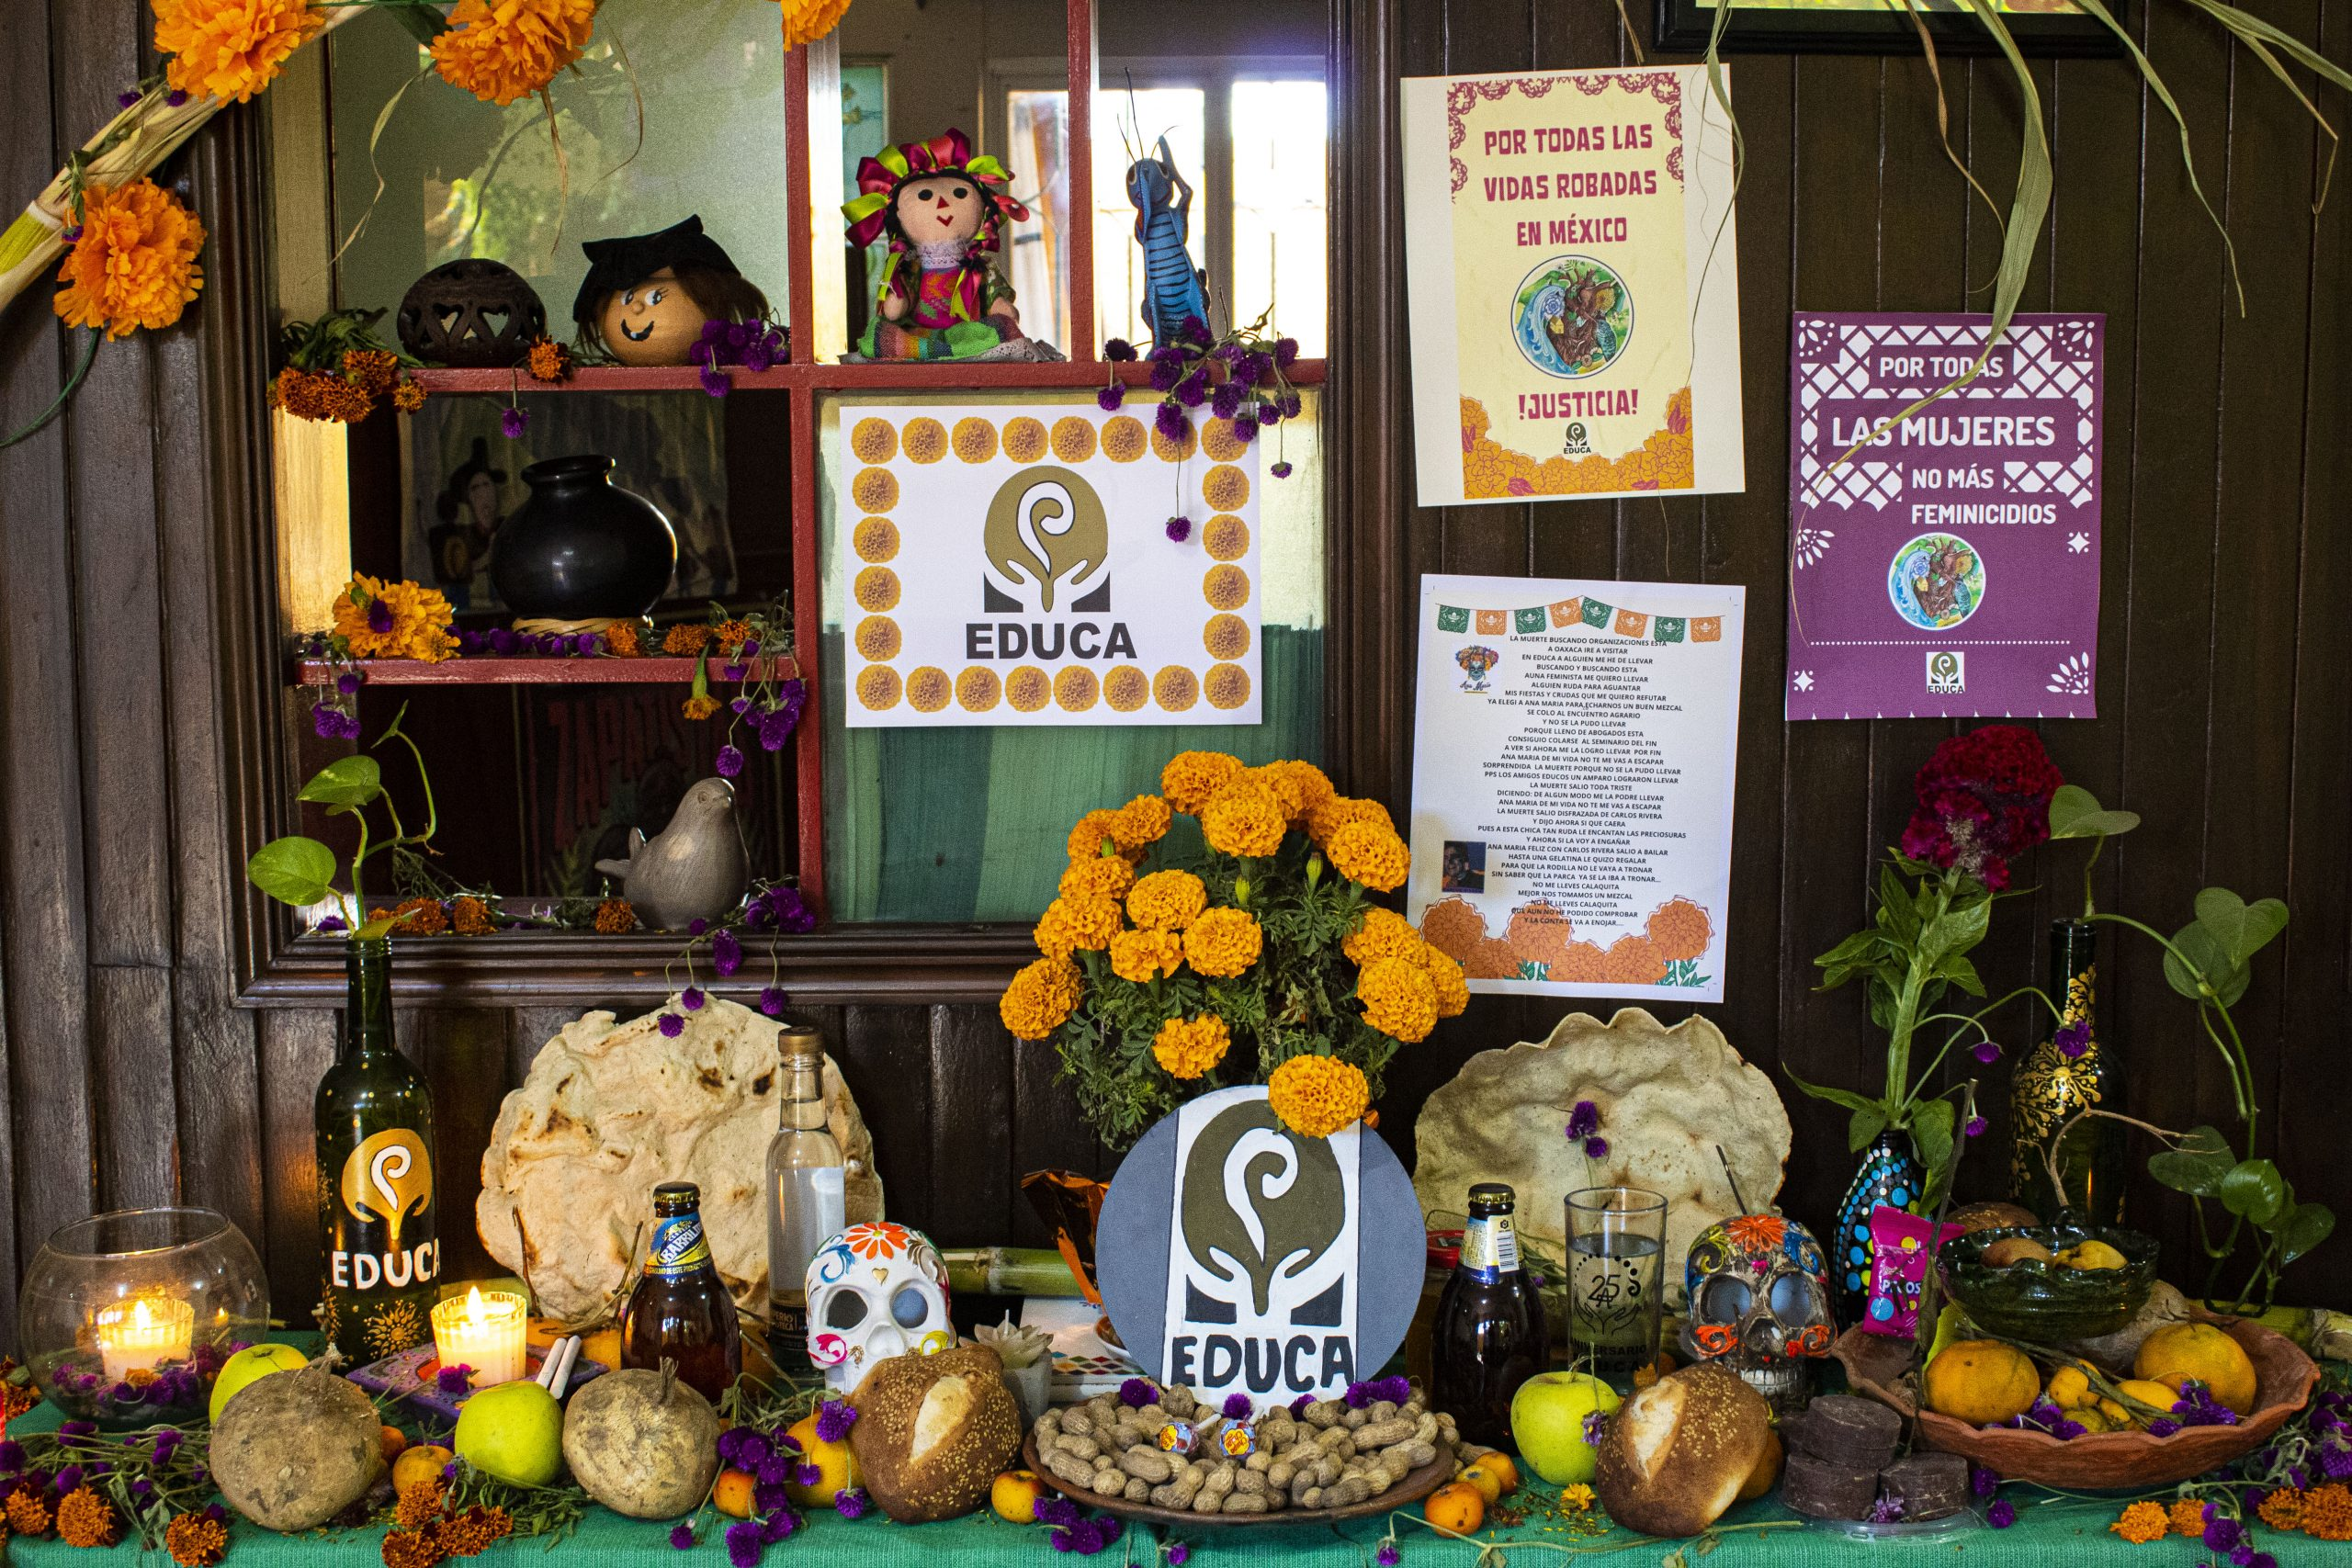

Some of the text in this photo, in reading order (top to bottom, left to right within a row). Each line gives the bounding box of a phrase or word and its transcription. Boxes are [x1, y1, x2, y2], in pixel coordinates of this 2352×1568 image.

[1484, 124, 1653, 156] POR TODAS LAS
[1484, 170, 1657, 202] VIDAS ROBADAS
[1517, 213, 1627, 246] EN MÉXICO
[1880, 356, 2004, 378] POR TODAS
[1519, 389, 1639, 421] !JUSTICIA!
[1832, 416, 2056, 447] LAS MUJERES
[1563, 446, 1591, 455] EDUCA
[1912, 463, 1995, 489] NO MÁS
[1911, 504, 2057, 525] FEMINICIDIOS
[966, 622, 1137, 660] EDUCA
[1549, 637, 1588, 645] BUSCANDO
[1589, 637, 1649, 647] ORGANIZACIONES
[1555, 646, 1583, 654] OAXACA
[1582, 665, 1621, 673] BUSCANDO
[1595, 674, 1623, 683] QUIERO
[1623, 675, 1649, 683] LLEVAR
[1927, 684, 1964, 694] EDUCA
[1566, 710, 1609, 718] ENCUENTRO
[1601, 720, 1626, 728] LLEVAR
[1524, 728, 1553, 736] PORQUE
[1589, 729, 1626, 738] ABOGADOS
[1508, 736, 1547, 744] CONSIGUIO
[1548, 737, 1578, 745] COLARSE
[1483, 762, 1532, 771] SORPRENDIDA
[1574, 765, 1602, 773] PORQUE
[1513, 772, 1541, 780] AMIGOS
[1613, 775, 1652, 784] LOGRARON
[1653, 776, 1679, 784] LLEVAR
[1544, 791, 1568, 799] ALGUN
[1569, 792, 1592, 800] MODO
[1557, 810, 1600, 818] DISFRAZADA
[1539, 818, 1555, 827] DIJO
[1555, 818, 1579, 827] AHORA
[1588, 820, 1602, 829] QUE
[1592, 856, 1614, 864] QUIZO
[1556, 882, 1580, 890] LLEVES
[1581, 883, 1620, 892] CALAQUITA
[1518, 890, 1541, 898] MEJOR
[1557, 891, 1593, 899] TOMAMOS
[1579, 901, 1618, 910] CALAQUITA
[1595, 910, 1638, 919] COMPROBAR
[1171, 1335, 1355, 1393] EDUCA
